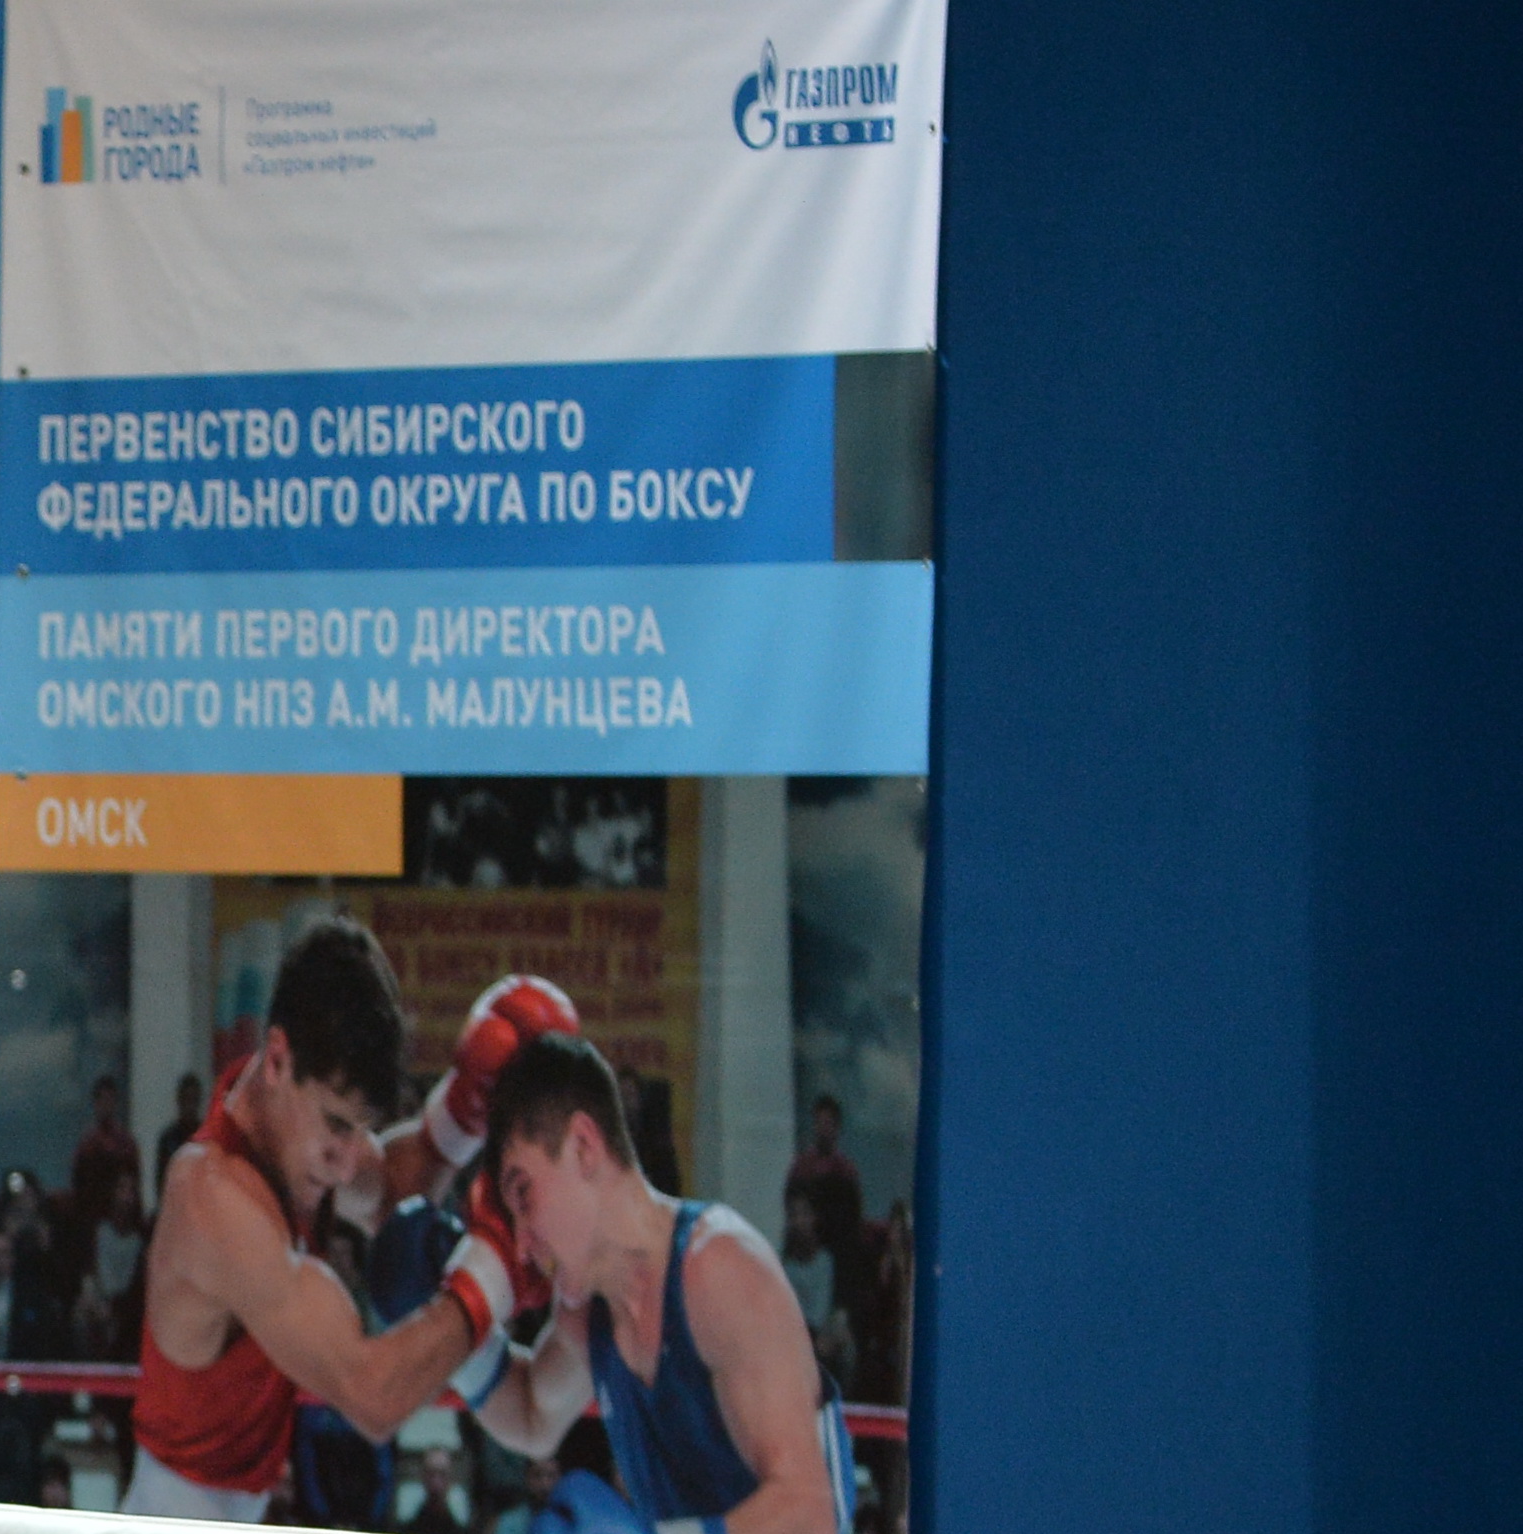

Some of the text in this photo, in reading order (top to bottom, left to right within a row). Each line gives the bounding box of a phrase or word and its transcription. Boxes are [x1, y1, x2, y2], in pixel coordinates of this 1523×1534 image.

[786, 64, 898, 109] ГАЗПРОМ
[103, 103, 199, 138] РОДНЫЕ
[103, 143, 200, 181] ГОРОДА
[39, 400, 585, 463] ПЕРВЕНСТВО СИБИРСКОГО
[37, 466, 753, 541] ФЕДЕРАЛЬНОГО ОКРУГА ПО БОКСУ
[39, 605, 665, 667] ПАМЯТИ ПЕРВОГО ДИРЕКТОРА
[38, 676, 693, 738] ОМСКОГО НПЗ А.М. МАЛУНЦЕВА
[37, 797, 148, 847] ОМСК
